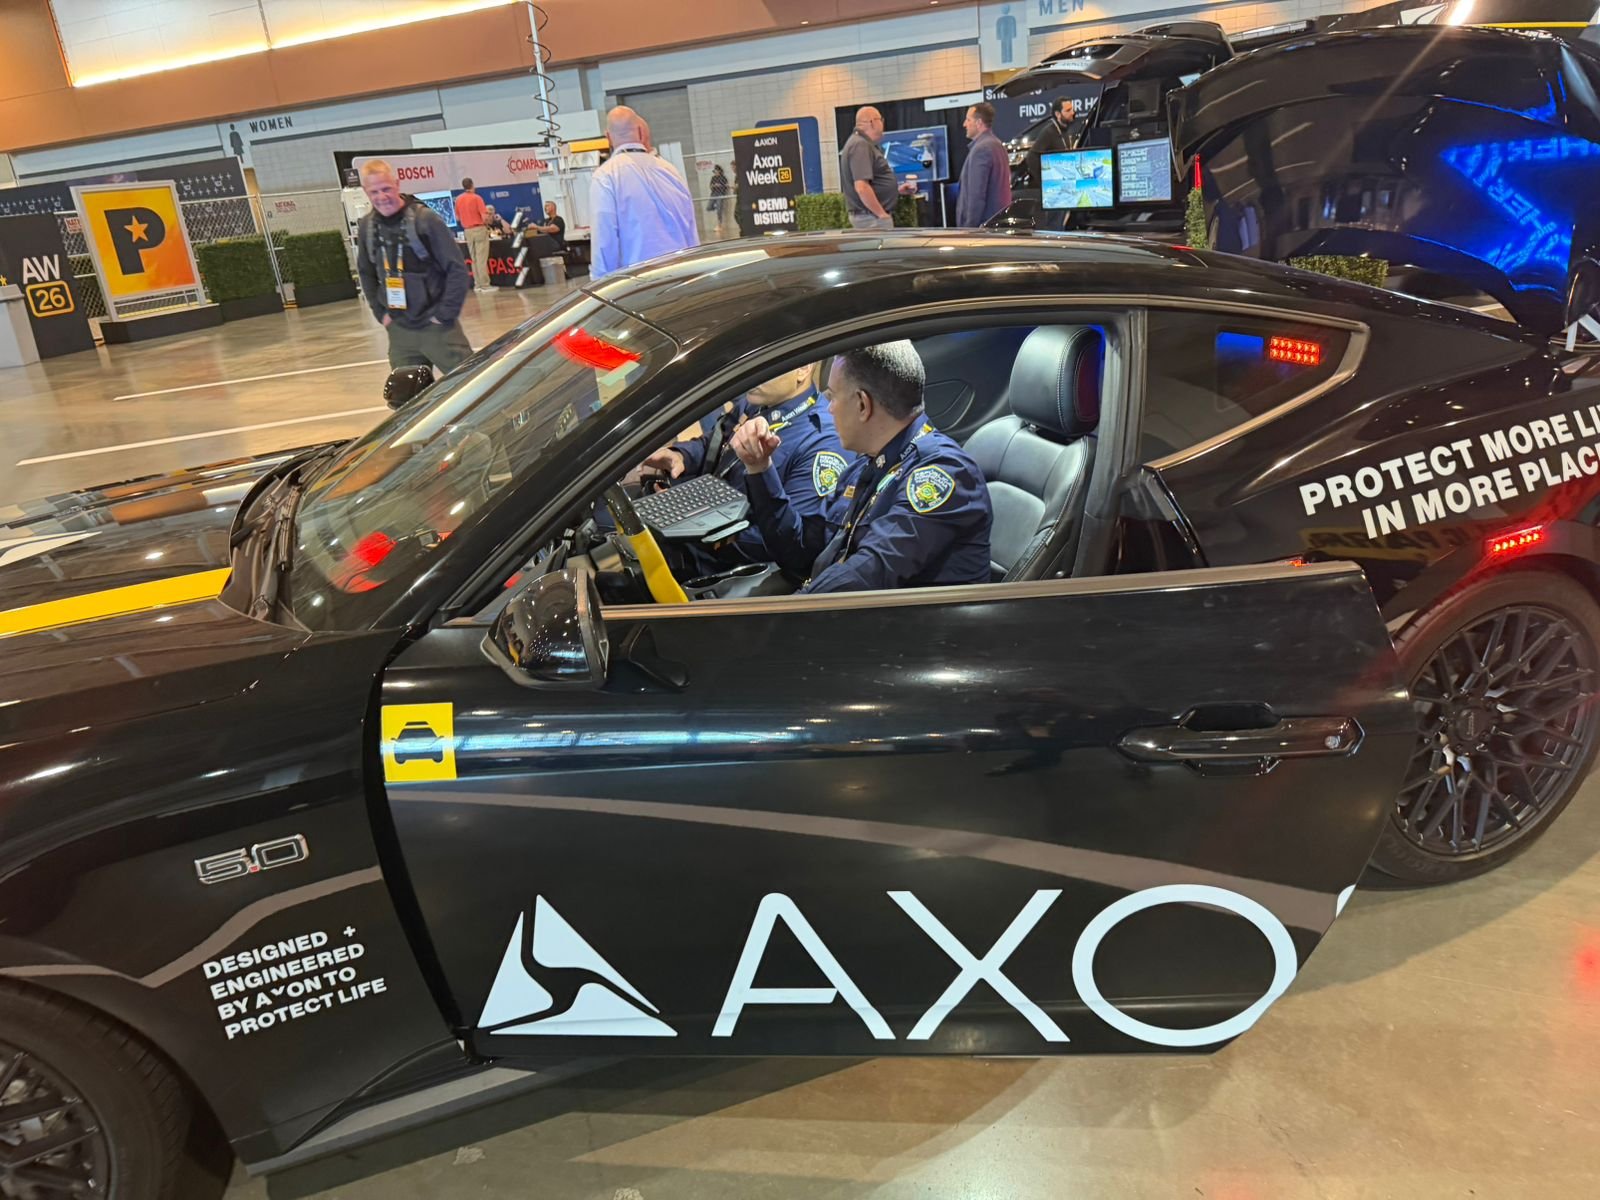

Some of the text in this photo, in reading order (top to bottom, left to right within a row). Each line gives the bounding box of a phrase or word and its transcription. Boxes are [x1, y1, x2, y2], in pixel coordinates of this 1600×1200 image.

[1039, 0, 1084, 16] MEN
[1019, 103, 1047, 118] FIND
[249, 115, 293, 133] WOMEN
[759, 137, 778, 146] AXON
[397, 165, 435, 181] BOSCH
[510, 158, 548, 172] COMPAS
[753, 153, 783, 170] Axon
[746, 169, 778, 186] Week
[758, 197, 789, 212] DEMO
[753, 210, 795, 226] DISTRICT
[104, 206, 166, 276] P
[22, 254, 61, 285] AW
[35, 286, 66, 311] 26
[1299, 404, 1600, 516] PROTECT MORE LI
[1361, 500, 1407, 540] IN
[1411, 467, 1519, 525] MORE
[194, 833, 310, 884] 5.0
[202, 930, 329, 979] DESIGNED
[711, 884, 1356, 1047] AXO
[210, 942, 365, 1000] ENGINEERED
[217, 997, 249, 1020] BY
[323, 966, 357, 986] TO
[224, 977, 388, 1040] PROTECT LIFE
